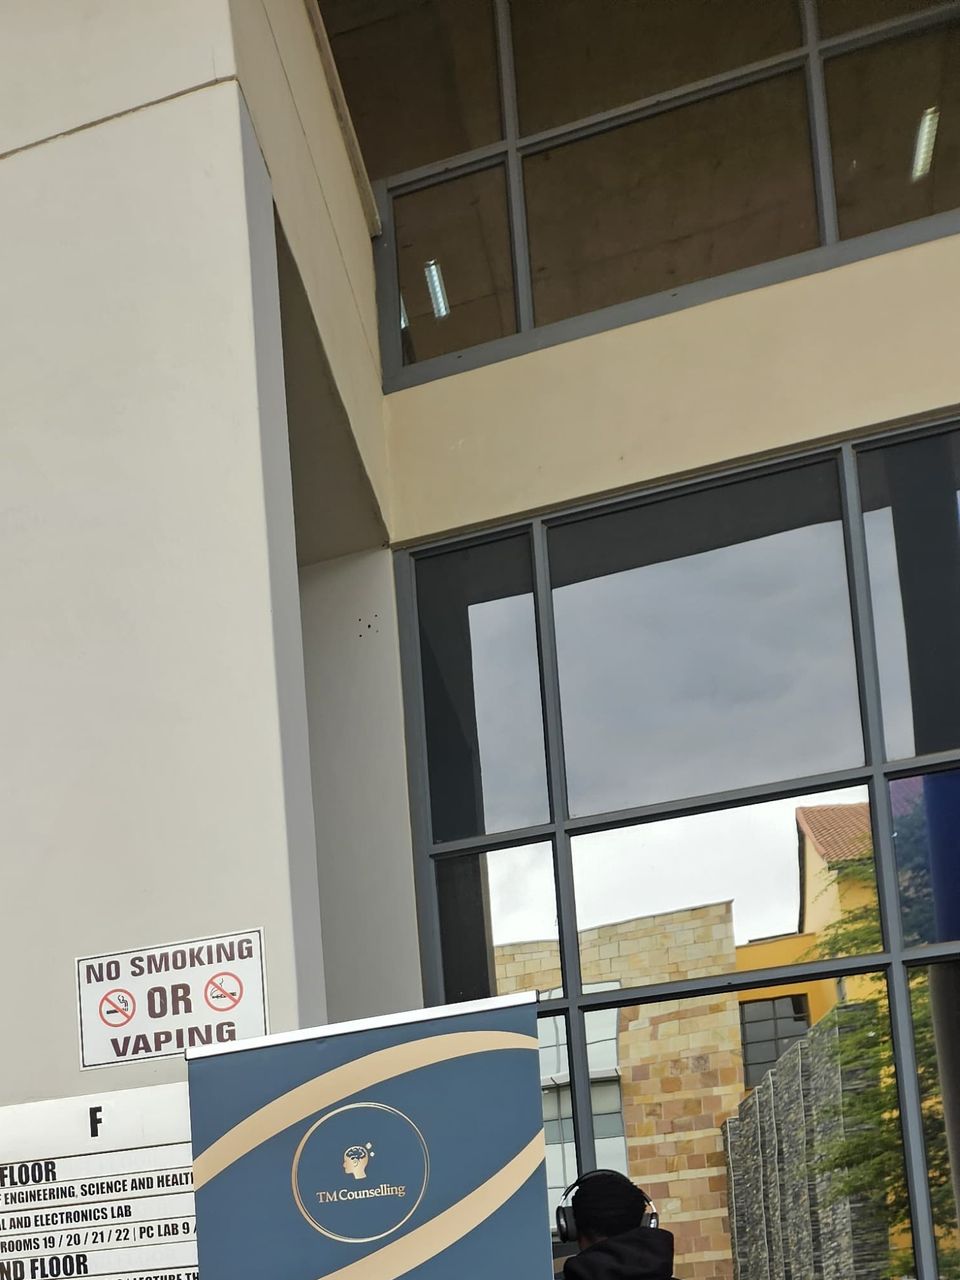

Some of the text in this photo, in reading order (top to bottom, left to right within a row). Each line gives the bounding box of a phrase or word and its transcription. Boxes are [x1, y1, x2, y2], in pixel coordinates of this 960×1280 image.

[87, 938, 253, 984] NO SMOKING
[147, 983, 192, 1019] OR
[111, 1021, 236, 1057] VAPING
[89, 1106, 102, 1137] F
[0, 1161, 57, 1186] FLOOR
[4, 1186, 78, 1205] ENGINEERING,
[80, 1180, 127, 1196] SCIENCE
[131, 1177, 153, 1191] AND
[9, 1216, 31, 1230] AND
[34, 1208, 108, 1227] ELECTRONICS
[111, 1205, 131, 1218] LAB
[0, 1238, 40, 1253] ROOMS
[42, 1236, 55, 1249] 19
[66, 1234, 80, 1246] 20
[92, 1231, 104, 1244] 21
[115, 1228, 129, 1241] 22
[139, 1226, 154, 1239] PC
[157, 1223, 177, 1237] LAB
[182, 1221, 189, 1235] 9
[30, 1254, 88, 1279] FLOOR
